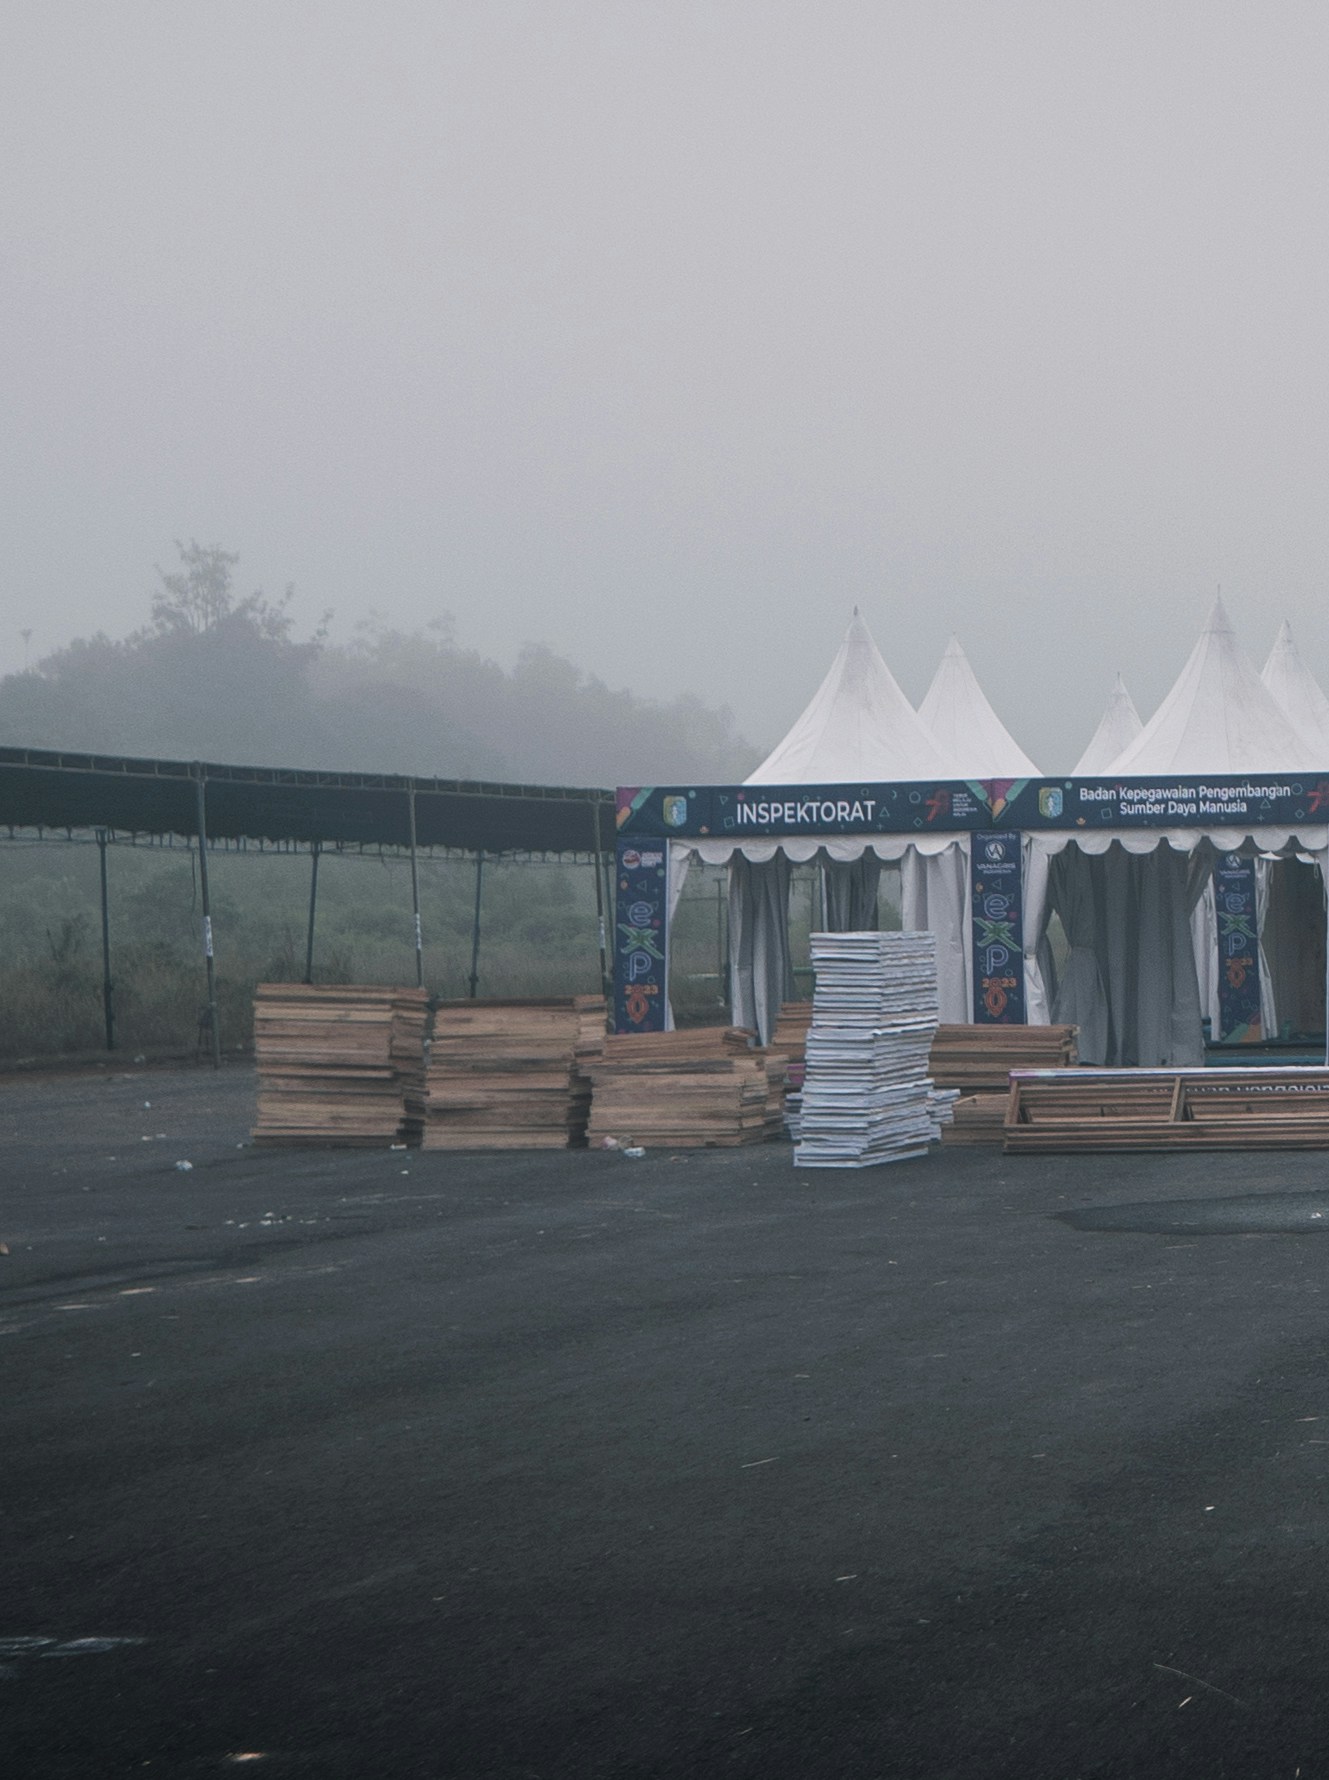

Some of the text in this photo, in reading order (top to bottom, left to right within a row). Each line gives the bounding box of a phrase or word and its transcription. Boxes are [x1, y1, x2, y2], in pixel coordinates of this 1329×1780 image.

[1079, 783, 1291, 802] Badan Kepegawaian Pengembangan
[737, 800, 876, 824] INSPEKTORAT
[1120, 799, 1247, 816] Sumber Daya Manusia
[624, 984, 659, 995] 2023
